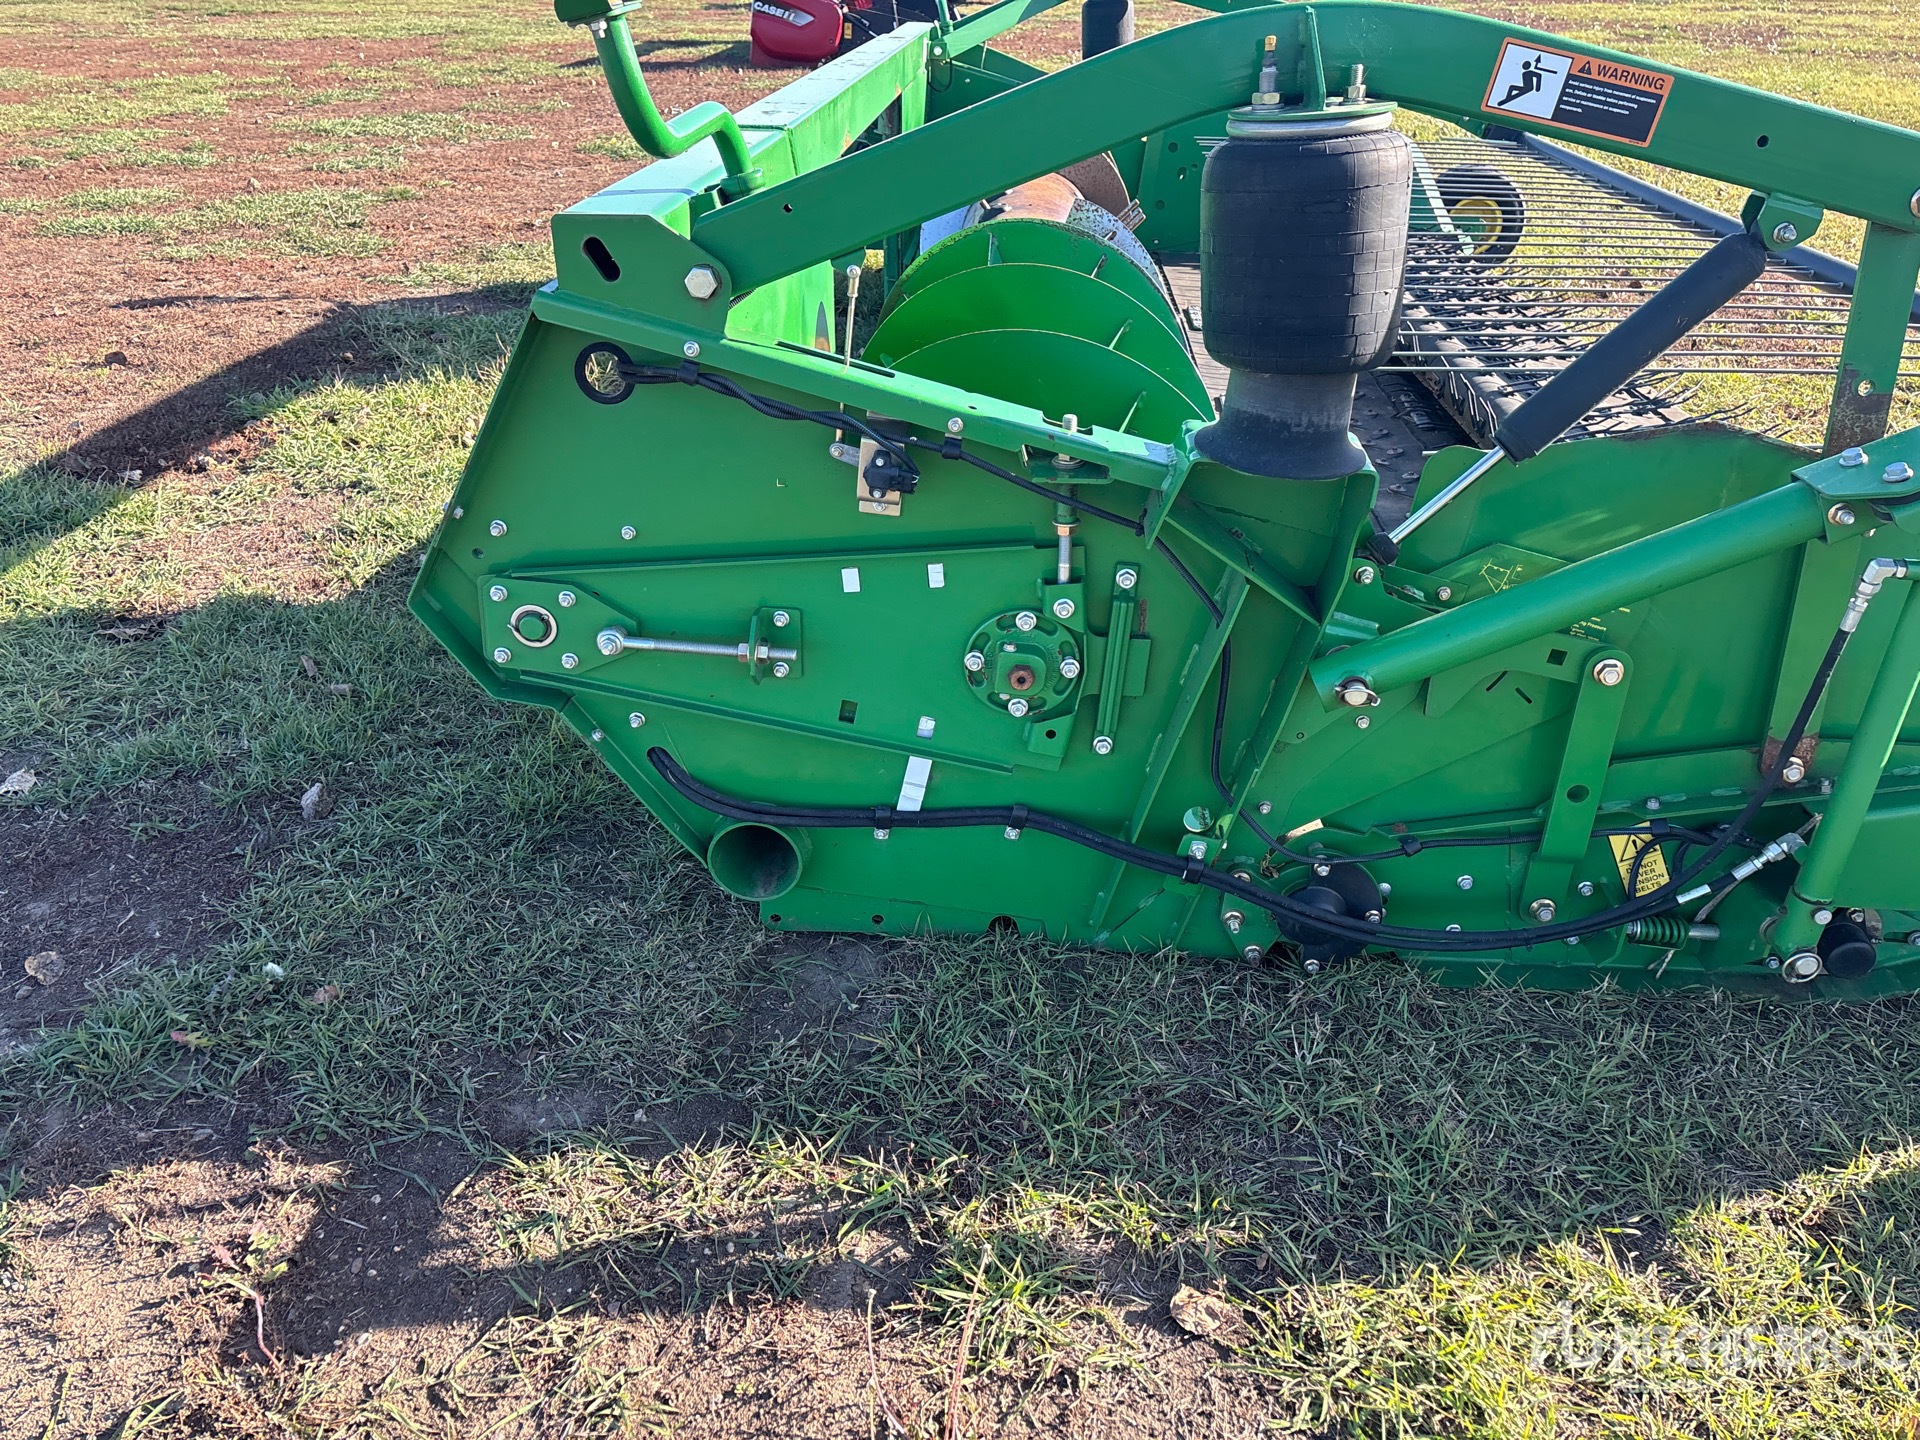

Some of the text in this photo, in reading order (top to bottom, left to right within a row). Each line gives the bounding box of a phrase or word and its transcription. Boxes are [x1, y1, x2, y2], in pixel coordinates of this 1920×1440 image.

[1597, 64, 1666, 91] WARNING
[1641, 859, 1658, 870] NOT
[1635, 880, 1662, 894] BELTS
